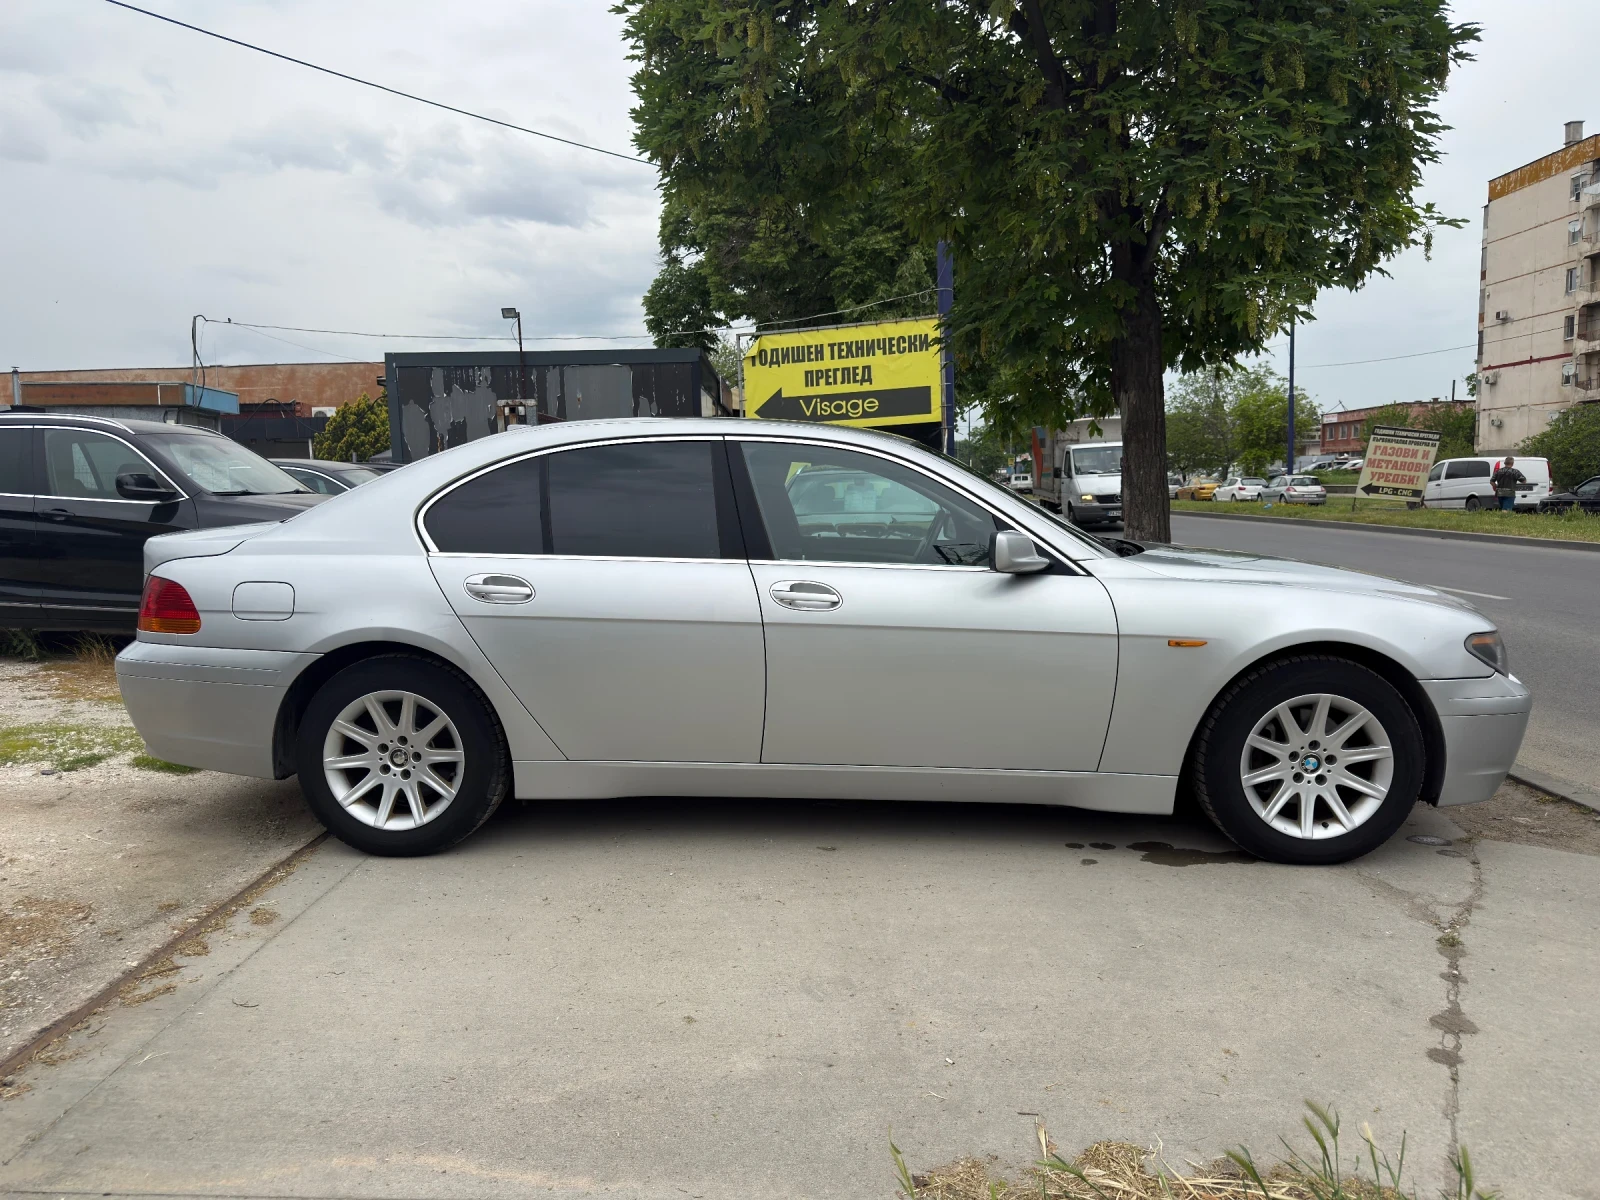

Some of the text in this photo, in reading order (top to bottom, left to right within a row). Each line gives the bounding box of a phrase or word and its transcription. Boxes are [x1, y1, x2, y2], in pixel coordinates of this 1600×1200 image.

[827, 333, 929, 361] ТЕХНИЧЕСКИ
[804, 364, 873, 388] ПРЕГЛЕД
[799, 397, 879, 417] Visage
[1373, 445, 1431, 460] ГАЗОВИ И
[1366, 457, 1431, 473] МЕТАНОВИ
[1370, 471, 1420, 485] УРЕДБИ!
[1379, 487, 1393, 495] LPG
